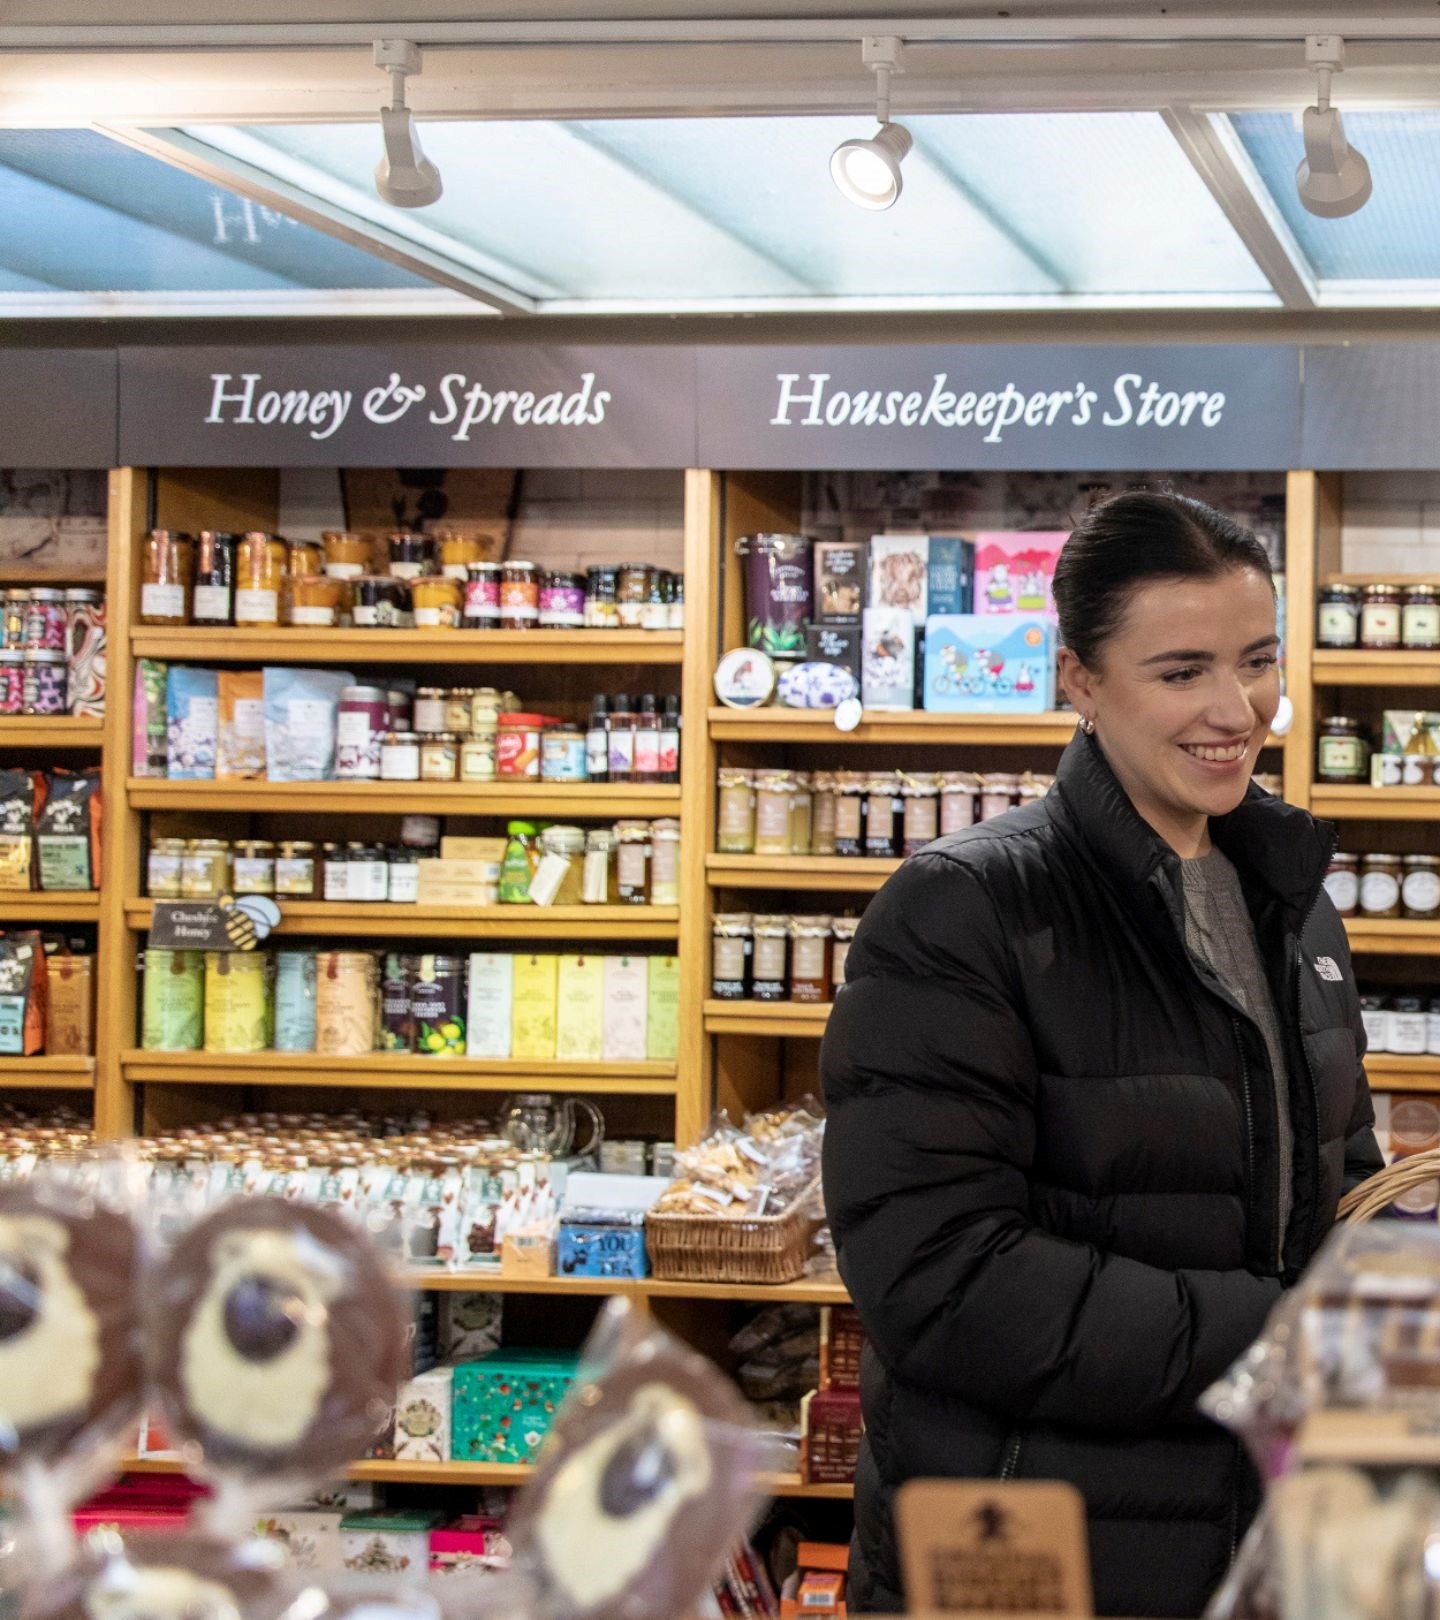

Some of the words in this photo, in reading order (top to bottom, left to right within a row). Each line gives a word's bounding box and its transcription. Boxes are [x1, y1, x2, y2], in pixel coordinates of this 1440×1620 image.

[204, 373, 352, 440] Honey
[362, 372, 426, 425] &
[429, 373, 611, 441] Spreads
[770, 373, 1098, 443] Housekeeper's
[1103, 373, 1225, 426] Store
[174, 925, 211, 940] Honey
